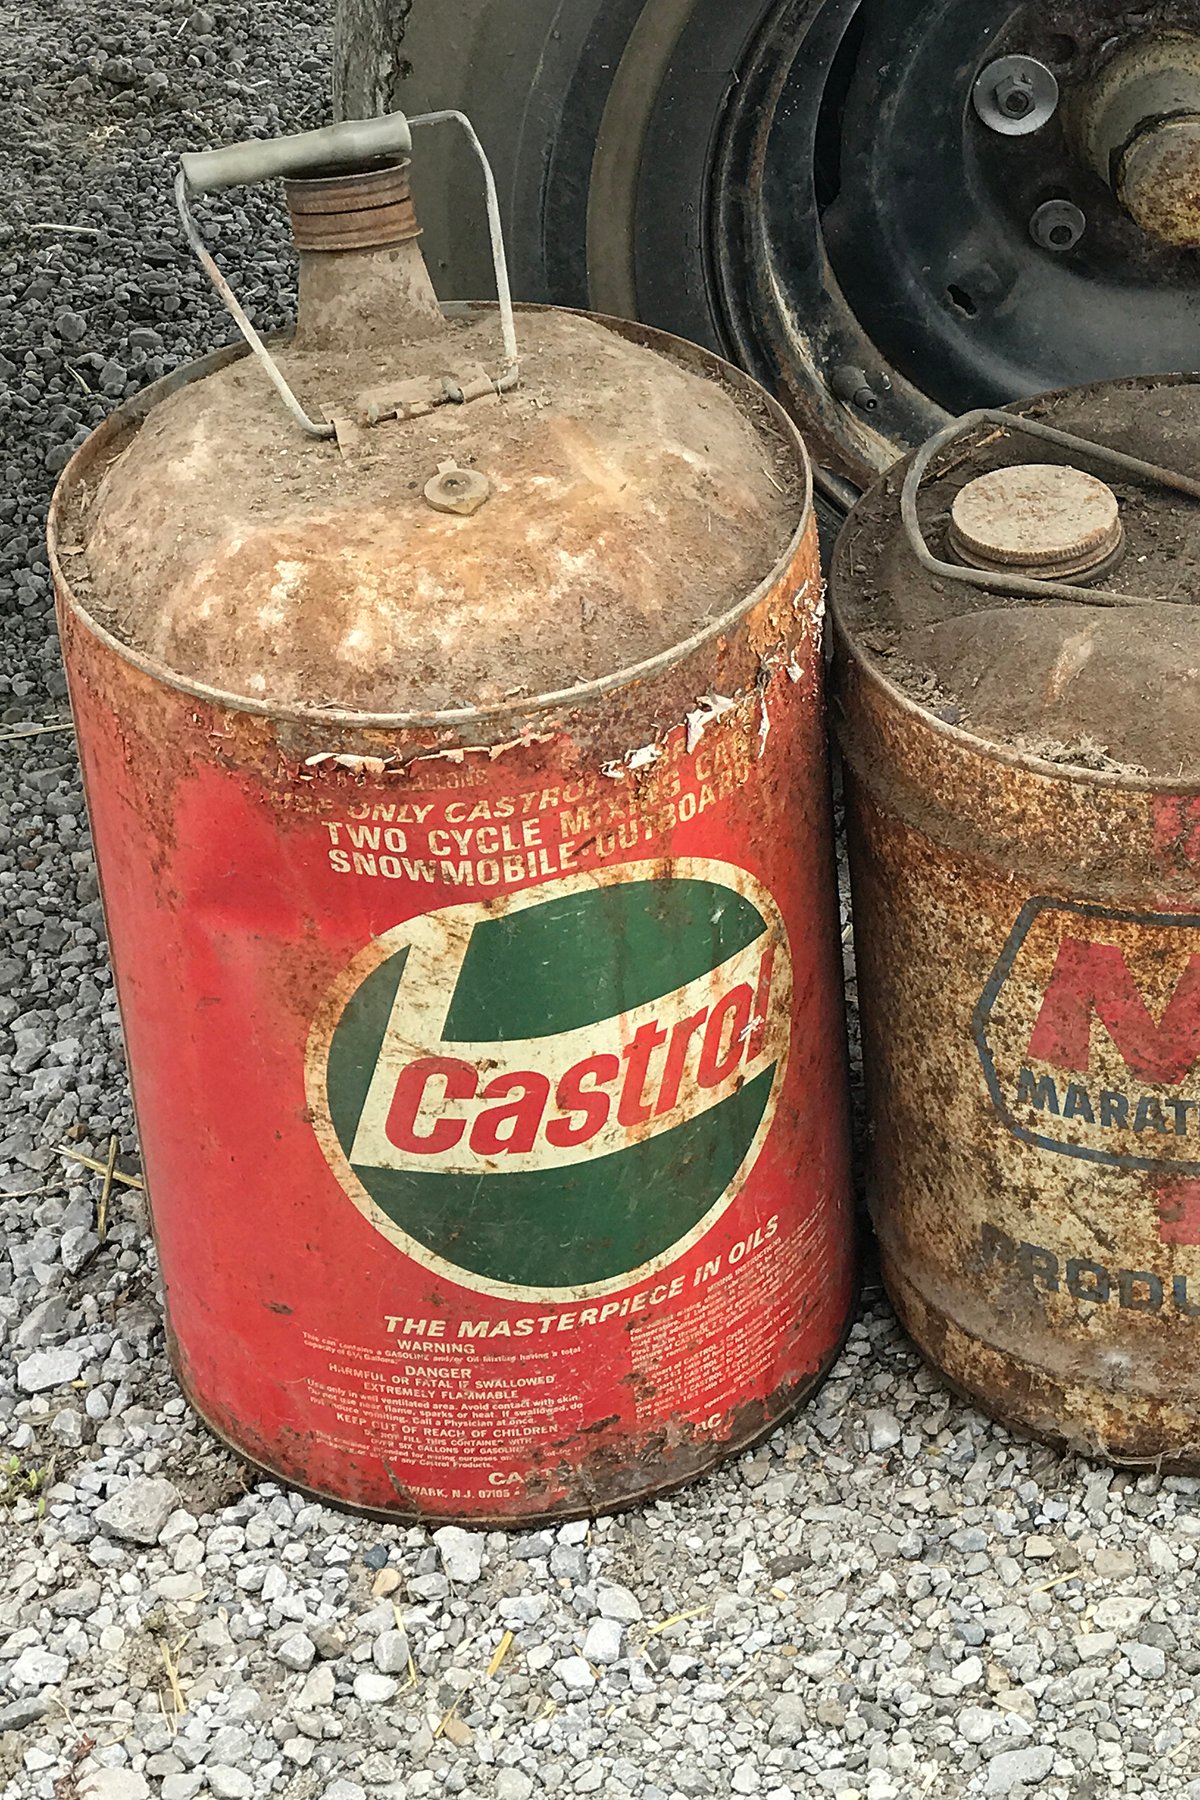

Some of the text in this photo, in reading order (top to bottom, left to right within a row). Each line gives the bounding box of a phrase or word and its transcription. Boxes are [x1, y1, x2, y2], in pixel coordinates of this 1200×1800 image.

[347, 802, 435, 824] ONLY
[320, 820, 408, 853] TWO
[428, 817, 543, 856] CYCLE
[327, 840, 578, 887] SNOWMOBILE
[384, 943, 774, 1156] Castrol
[384, 1315, 447, 1337] THE
[457, 1274, 686, 1338] MASTERPIECE
[693, 1255, 722, 1288] IN
[727, 1214, 779, 1265] OILS
[397, 1339, 475, 1354] WARNING
[329, 1363, 387, 1382] HARMFUL
[391, 1375, 409, 1385] OR
[415, 1378, 454, 1389] FATAL
[475, 1374, 555, 1389] SWALLOWED
[405, 1365, 472, 1379] DANGER
[364, 1382, 436, 1399] EXTREMELY
[461, 1403, 490, 1411] Avoid
[492, 1399, 530, 1410] contact
[532, 1398, 555, 1407] with
[336, 1412, 367, 1426] KEEP
[402, 1425, 418, 1434] OF
[423, 1428, 466, 1439] REACH
[471, 1430, 487, 1438] OF
[493, 1424, 558, 1438] CHILDREN
[444, 1419, 492, 1428] Physician
